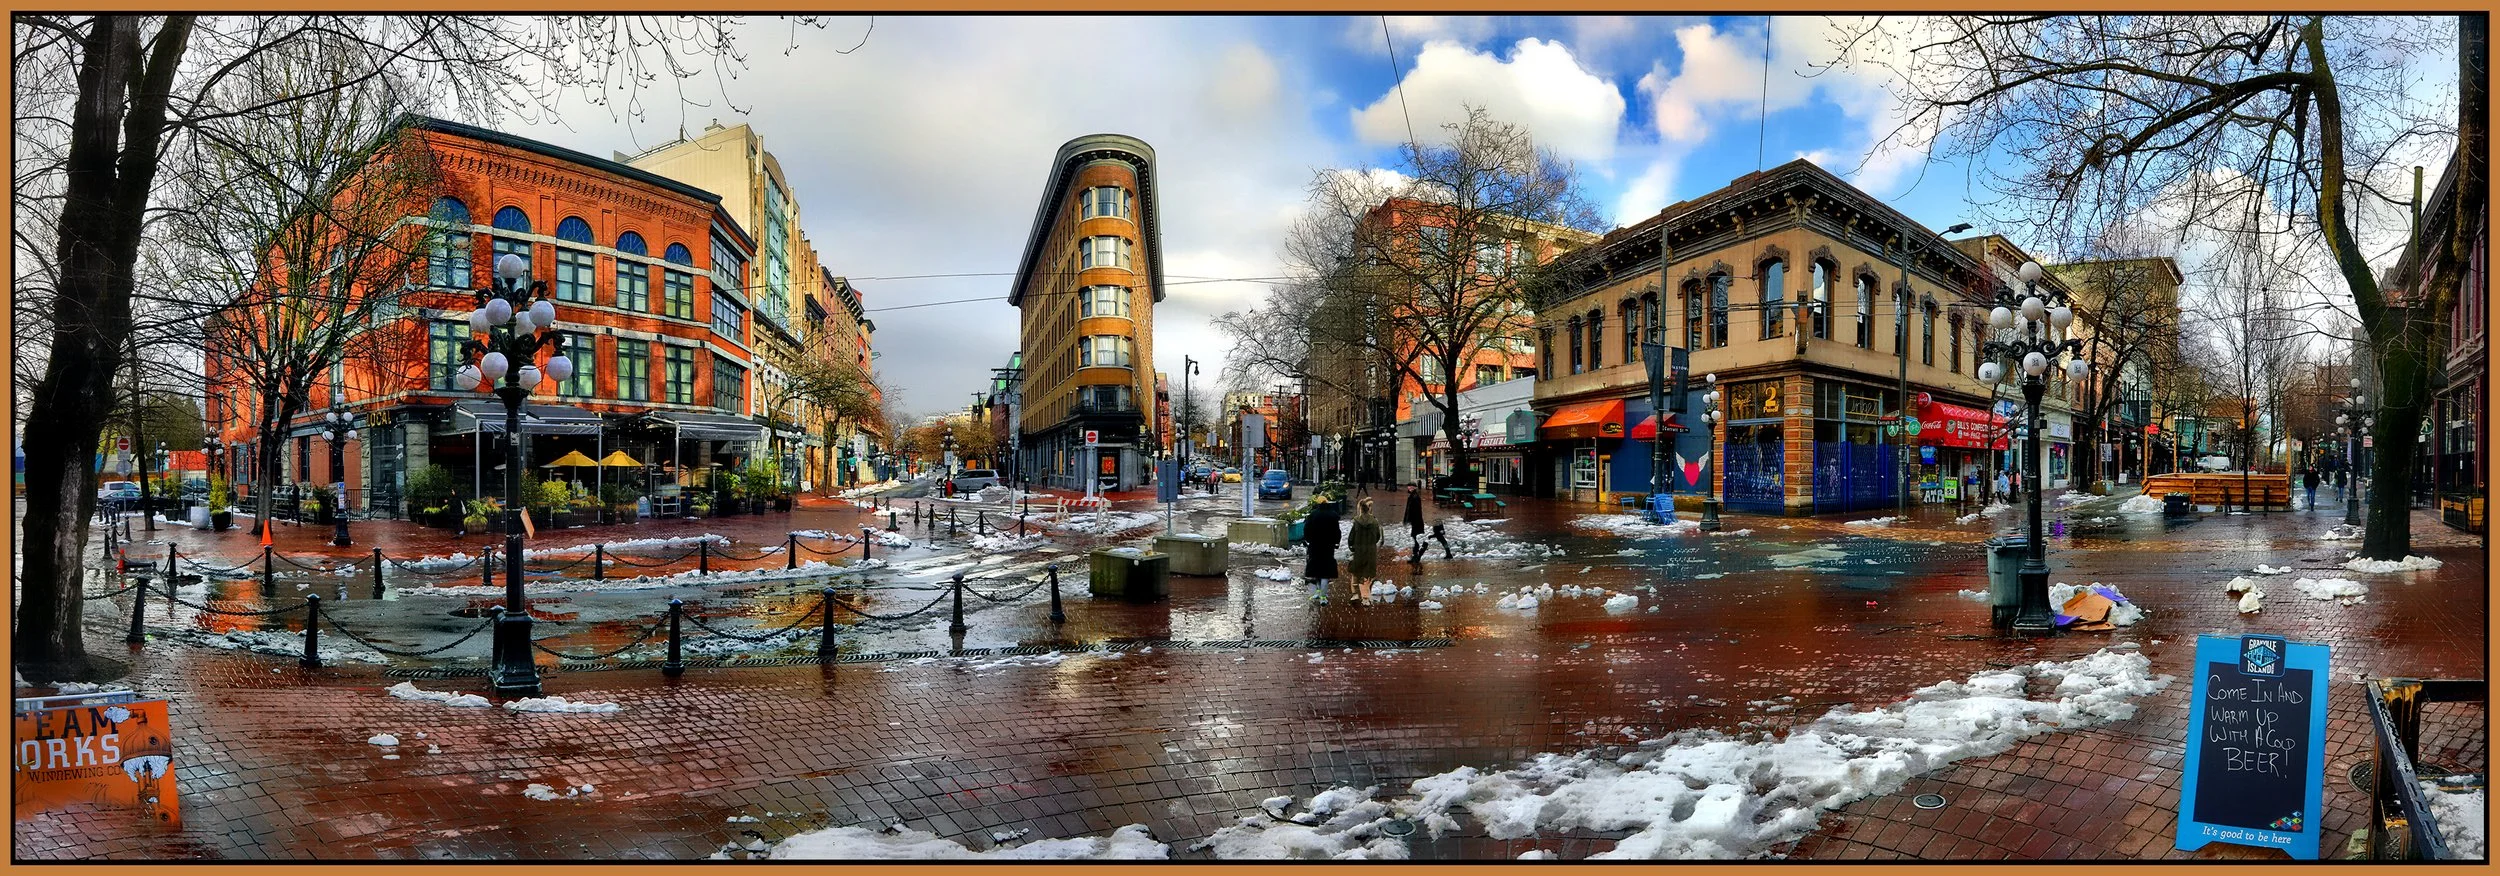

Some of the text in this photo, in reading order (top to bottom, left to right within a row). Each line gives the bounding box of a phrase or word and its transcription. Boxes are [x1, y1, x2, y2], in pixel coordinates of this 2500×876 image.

[1765, 387, 1776, 406] 2
[366, 410, 392, 427] LOCAL
[2248, 638, 2277, 653] GRANVILLE
[2251, 678, 2273, 703] IN
[2278, 682, 2304, 704] AND
[2211, 705, 2279, 731] WARM UP
[2209, 725, 2249, 744] WITH
[2255, 725, 2264, 748] A
[16, 733, 121, 770] ORKS
[2223, 747, 2288, 779] BEER!
[2202, 825, 2292, 844] It's good to be here
